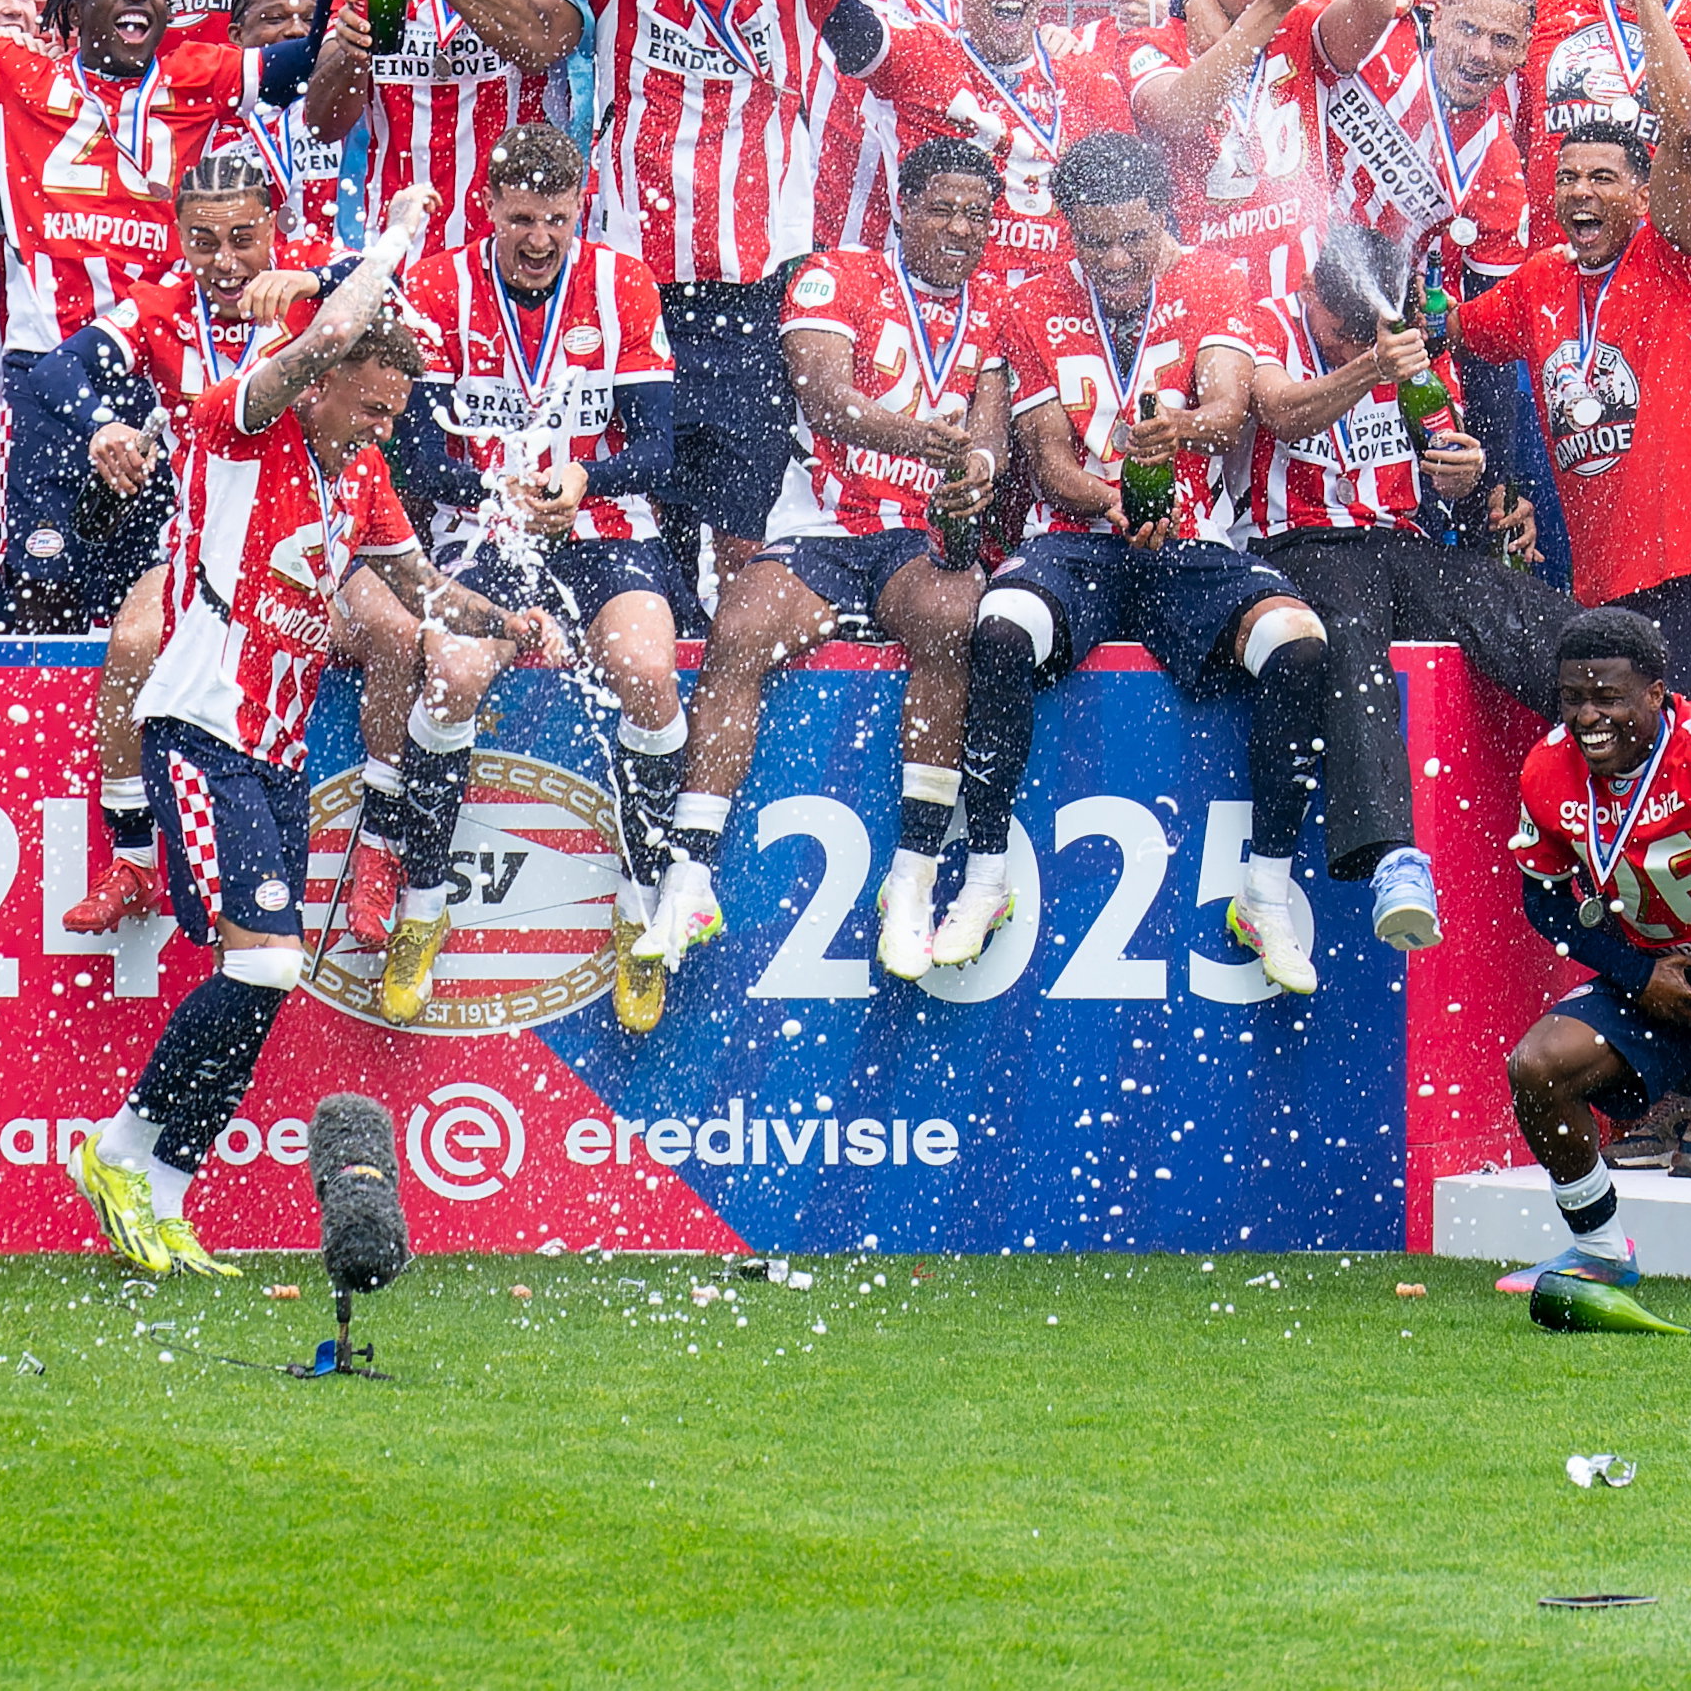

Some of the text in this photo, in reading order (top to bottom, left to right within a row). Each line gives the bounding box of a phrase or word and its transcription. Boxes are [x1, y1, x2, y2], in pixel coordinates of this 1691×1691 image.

[42, 73, 177, 202] 26
[1327, 101, 1431, 221] EINDHOVEN
[1341, 87, 1446, 211] BRAINPORT
[43, 211, 168, 252] KAMPIOEN
[798, 282, 830, 297] TOTO
[845, 445, 947, 494] KAMPIO
[252, 591, 332, 653] KAMPIOE
[446, 850, 530, 906] SV
[425, 1003, 453, 1024] ST
[564, 1099, 959, 1167] eredivisie
